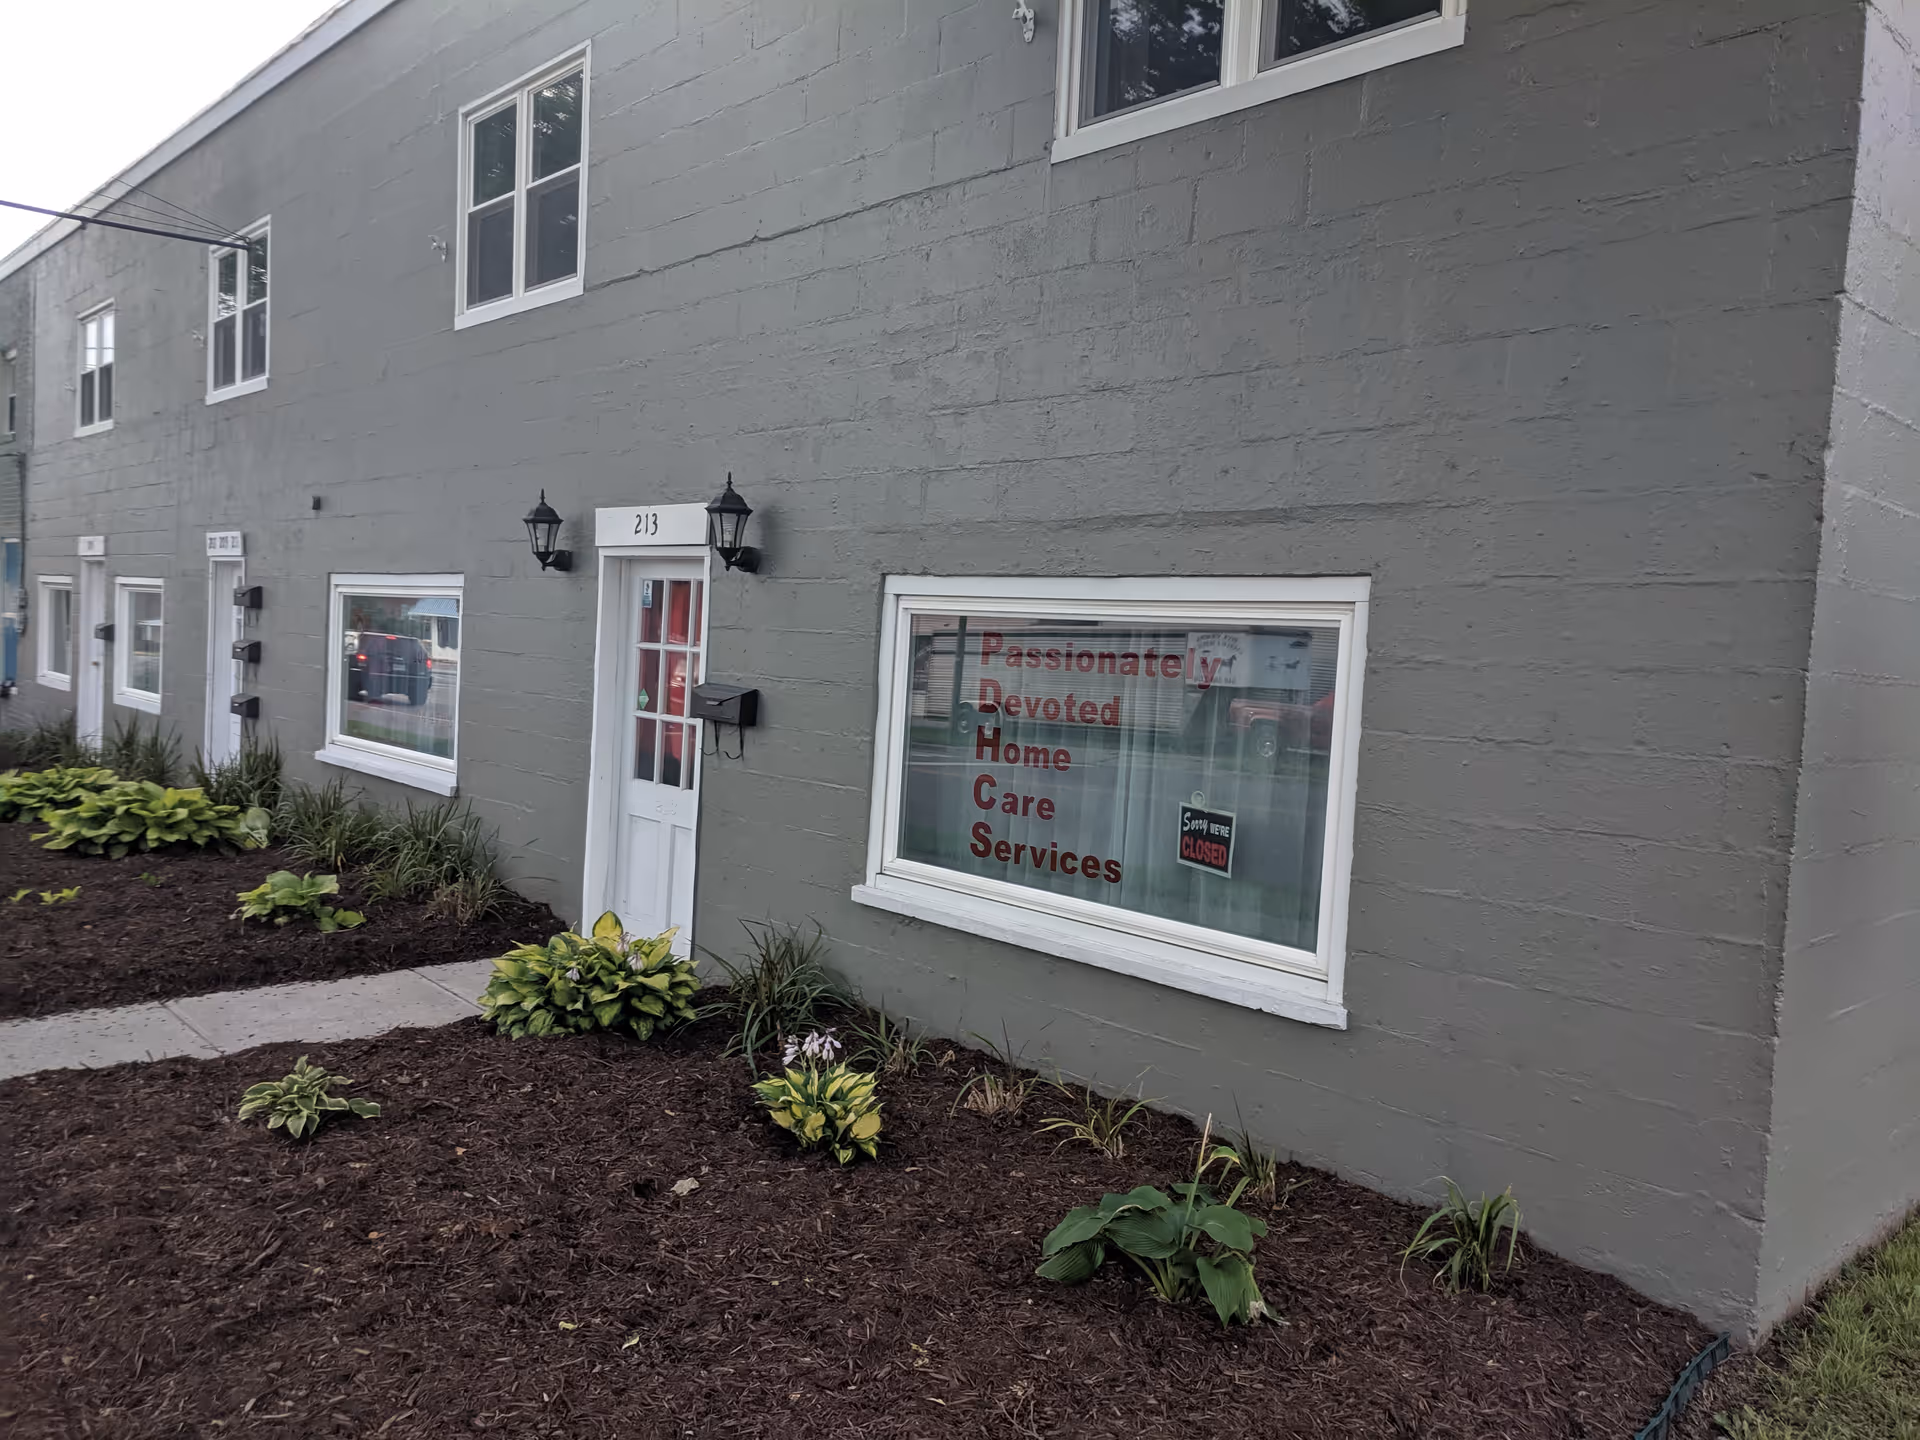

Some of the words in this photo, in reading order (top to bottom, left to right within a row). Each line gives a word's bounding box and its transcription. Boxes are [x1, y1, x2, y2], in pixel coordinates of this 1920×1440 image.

[634, 512, 658, 535] 213
[980, 631, 1222, 690] Passionately
[978, 678, 1122, 727] Devoted
[975, 725, 1072, 771] Home
[973, 773, 1056, 820] Care
[1182, 811, 1208, 836] Sorry
[1209, 822, 1230, 838] WE'RE
[969, 821, 1122, 883] Services
[1181, 835, 1228, 868] CLOSED
